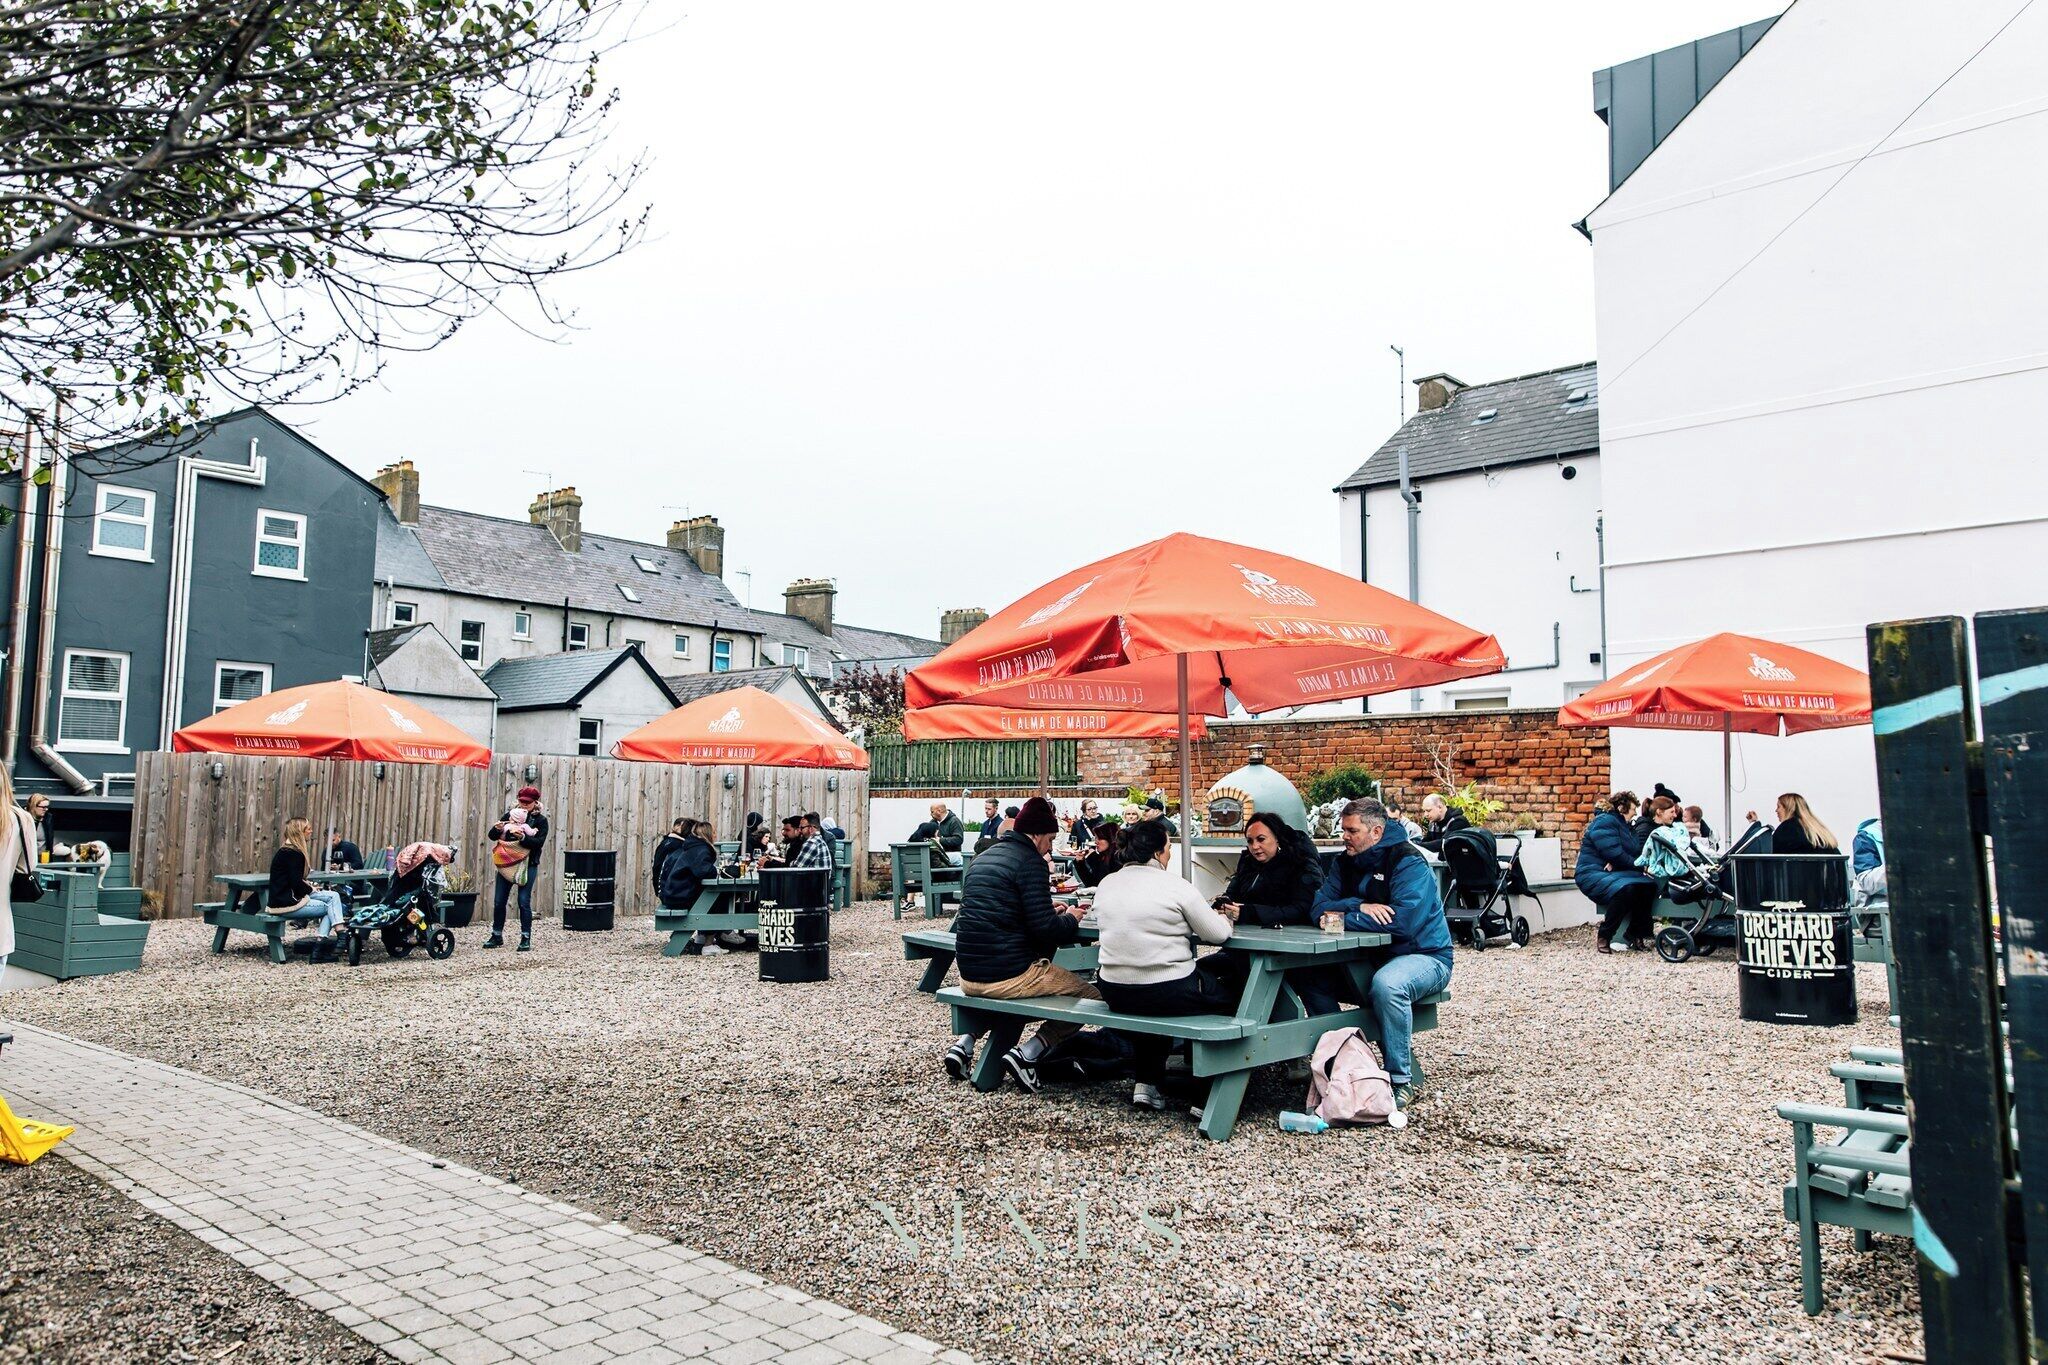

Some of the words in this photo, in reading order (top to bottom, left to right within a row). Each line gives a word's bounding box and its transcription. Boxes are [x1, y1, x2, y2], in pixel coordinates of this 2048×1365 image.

[1278, 621, 1320, 635] ALMA
[1337, 626, 1392, 646] MADRID
[992, 659, 1013, 683] ALMA
[1026, 648, 1057, 673] MADRID
[1743, 694, 1755, 706] EL
[1757, 694, 1782, 707] ALMA
[1784, 695, 1796, 708] DE
[1799, 696, 1835, 709] MADRID
[1001, 716, 1012, 730] EL
[1017, 716, 1045, 730] ALMA
[1049, 716, 1061, 729] DE
[1066, 716, 1107, 730] MADRID
[235, 737, 244, 748] EL
[245, 737, 264, 748] ALMA
[274, 739, 300, 749] MADRID
[682, 747, 690, 757] EL
[693, 747, 713, 758] ALMA
[715, 747, 725, 758] DE
[727, 748, 756, 758] MADRID
[758, 908, 795, 926] CHARD
[1742, 912, 1834, 940] ORCHARD
[758, 926, 795, 947] IEVES
[1744, 937, 1836, 970] THIEVES
[1766, 968, 1813, 979] CIDER
